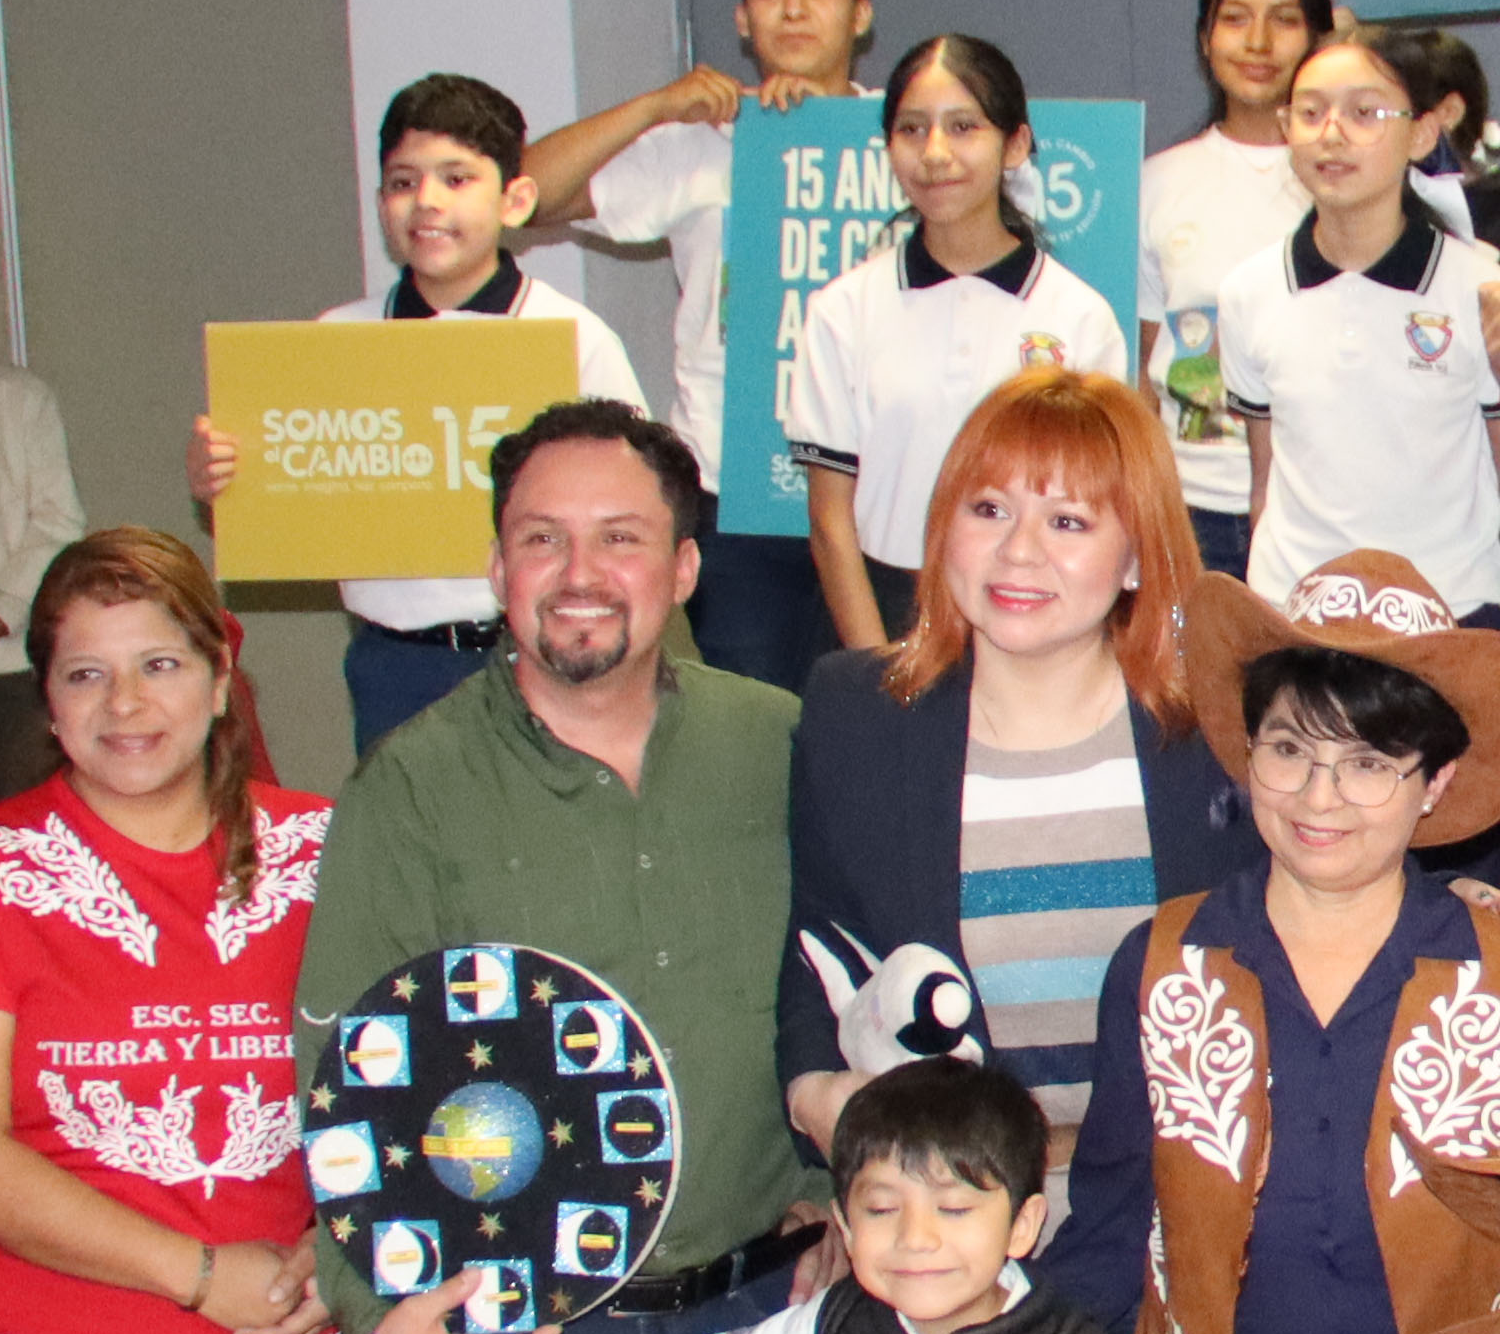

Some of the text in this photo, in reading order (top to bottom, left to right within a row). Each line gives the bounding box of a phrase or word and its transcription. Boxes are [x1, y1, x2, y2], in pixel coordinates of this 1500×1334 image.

[782, 136, 911, 212] 15 AÑ
[781, 218, 831, 281] DE
[263, 406, 511, 490] SOMOS 15
[264, 443, 434, 478] el CAMBIO
[131, 1002, 281, 1029] ESC. SEC.
[176, 1033, 203, 1060] Y
